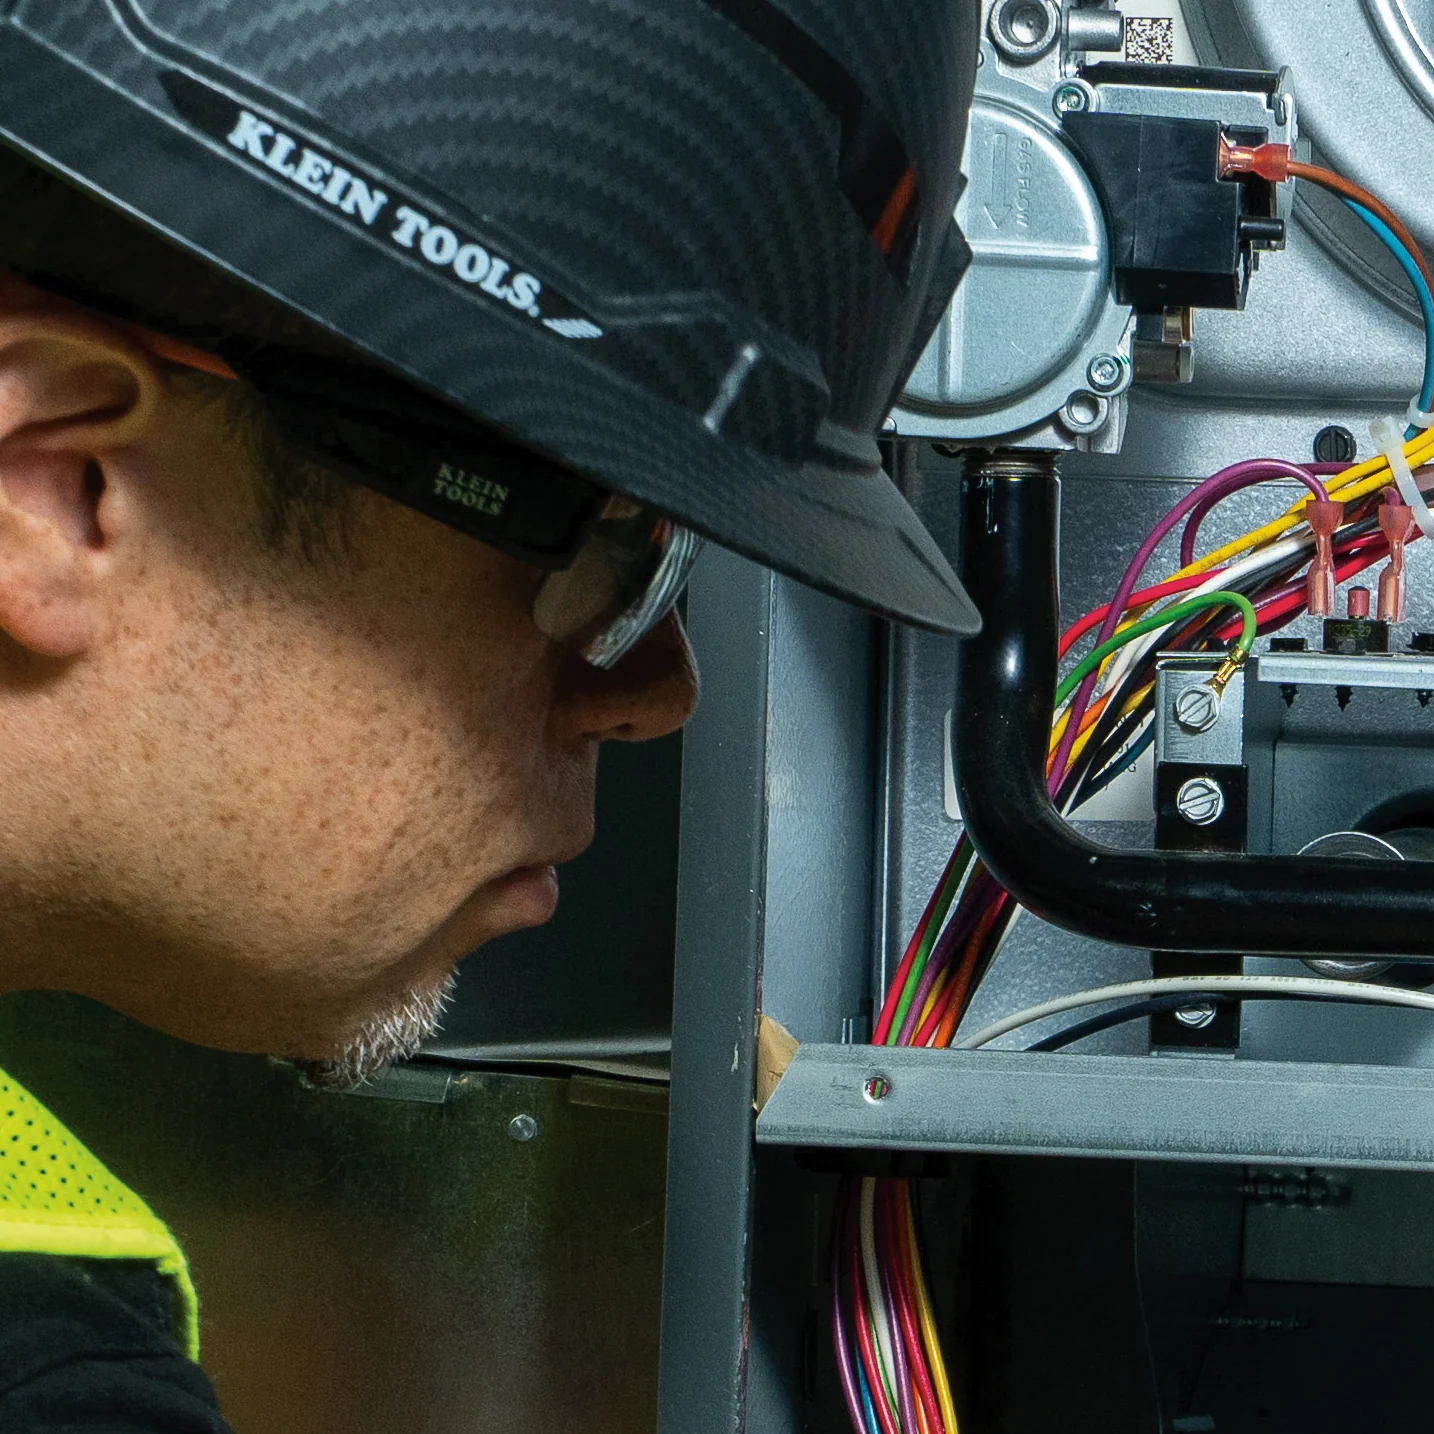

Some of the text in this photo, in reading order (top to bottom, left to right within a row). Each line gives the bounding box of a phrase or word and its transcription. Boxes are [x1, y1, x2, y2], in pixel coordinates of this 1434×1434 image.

[227, 110, 389, 225] KLEIN
[434, 479, 503, 516] TOOLS
[438, 463, 509, 501] KLEIN
